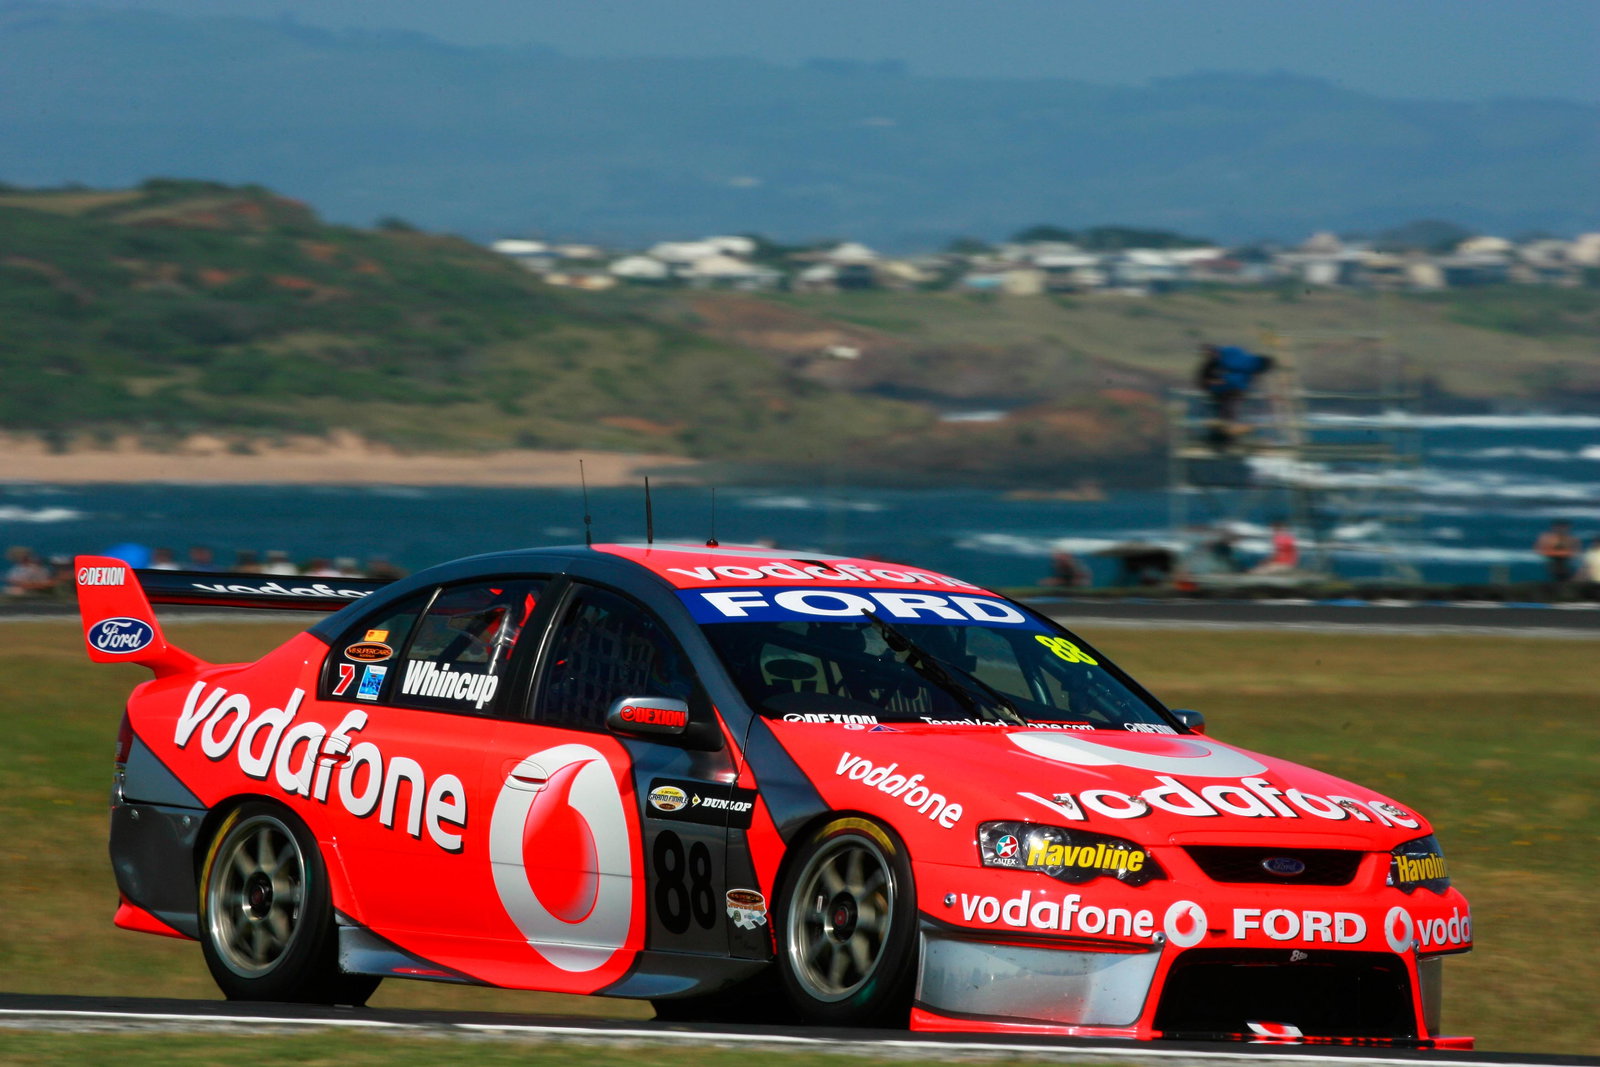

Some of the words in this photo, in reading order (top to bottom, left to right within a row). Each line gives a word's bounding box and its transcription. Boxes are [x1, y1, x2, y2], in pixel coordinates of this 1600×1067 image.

[87, 567, 125, 586] DEXION
[192, 582, 373, 599] vodafo
[666, 562, 981, 591] vodafone
[700, 590, 1026, 624] FORD
[97, 620, 143, 649] Ford
[1034, 634, 1099, 666] 88
[332, 663, 356, 696] 7
[402, 659, 499, 710] Whincup
[634, 706, 686, 728] DEXION
[174, 680, 467, 851] vodafone
[702, 797, 752, 812] DUNLOP
[835, 751, 964, 830] vodafone
[1017, 775, 1420, 829] vodafone
[992, 857, 1016, 866] CALTEX
[1026, 838, 1145, 872] Havoline
[653, 829, 717, 935] 88
[961, 889, 1154, 938] vodafone
[1232, 908, 1367, 943] FORD
